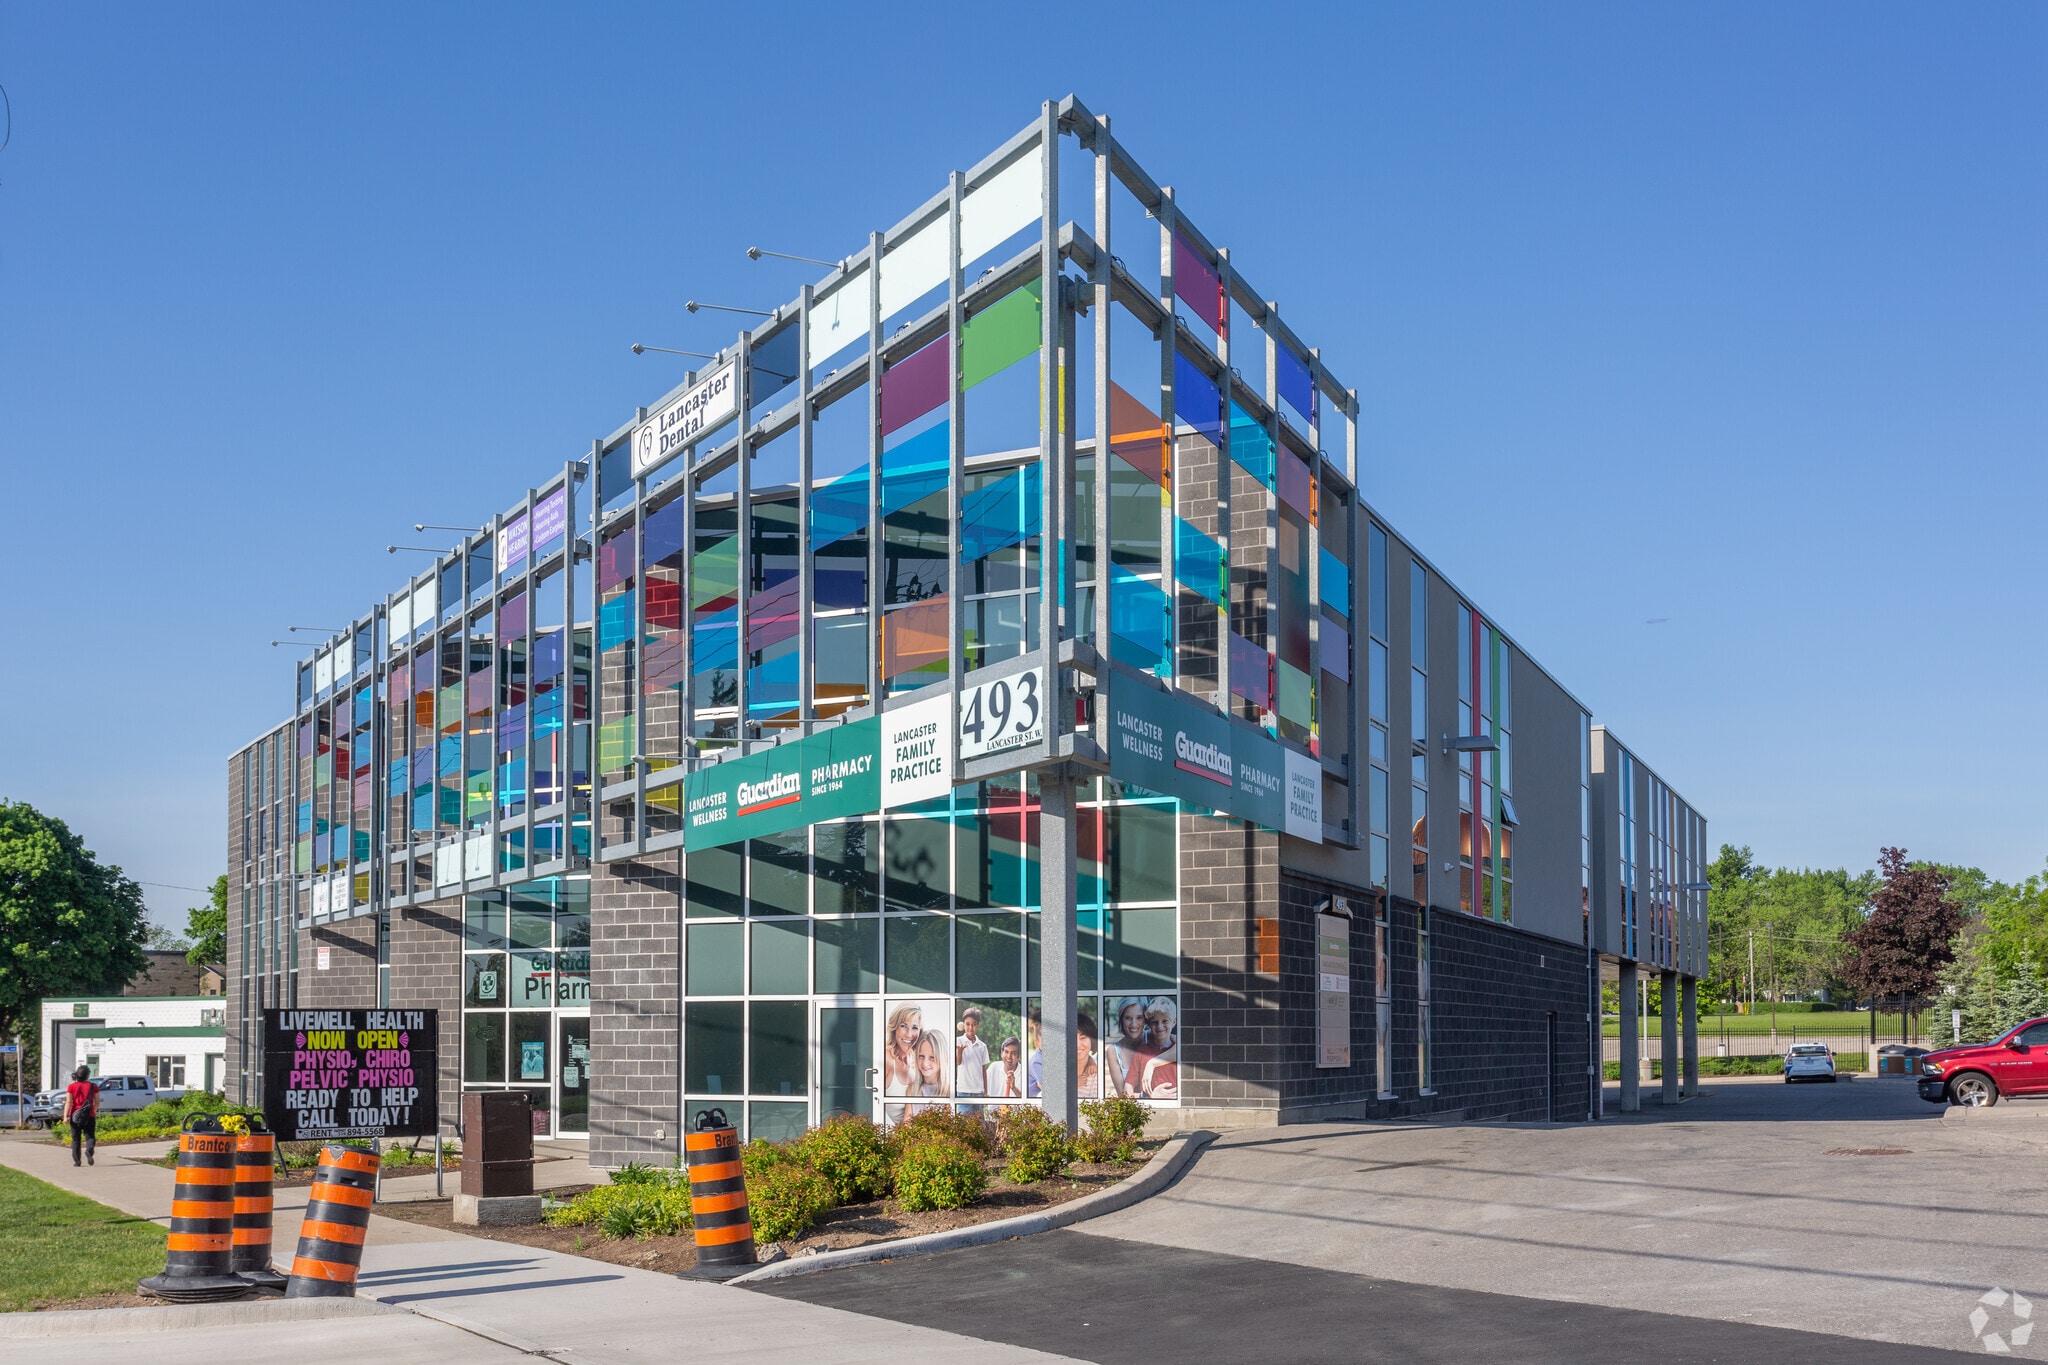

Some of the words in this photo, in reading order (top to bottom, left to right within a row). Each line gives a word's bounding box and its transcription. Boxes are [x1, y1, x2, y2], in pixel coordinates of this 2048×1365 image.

[659, 373, 729, 434] Lancaster
[659, 407, 705, 455] Dental
[508, 519, 527, 540] WATSON
[962, 671, 1039, 744] 493
[893, 722, 937, 744] LANCASTER
[1117, 711, 1163, 743] LANCASTER
[896, 738, 936, 763] FAMILY
[986, 734, 1024, 751] LANCASTER
[1025, 731, 1035, 743] ST.
[1035, 728, 1043, 739] W.
[1122, 733, 1163, 762] WELLNESS
[1174, 730, 1233, 776] Guardian
[811, 754, 872, 785] PHARMACY
[890, 757, 942, 784] PRACTICE
[1240, 763, 1281, 793] PHARMACY
[1291, 771, 1315, 789] LANCASTER
[737, 772, 800, 807] Guardian
[811, 785, 827, 796] SINCE
[828, 780, 843, 792] 1964
[1240, 782, 1253, 795] SINCE
[1254, 785, 1264, 797] 1964
[1293, 787, 1315, 806] FAMILY
[689, 791, 727, 813] LANCASTER
[1290, 803, 1318, 823] PRACTICE
[692, 807, 727, 827] WELLNESS
[279, 1011, 355, 1030] LIVEWELL
[366, 1011, 424, 1030] HEALTH
[307, 1031, 346, 1050] NOW
[357, 1030, 398, 1049] OPEN
[294, 1050, 358, 1069] PHYSIO,
[365, 1050, 411, 1068] CHIRO
[289, 1070, 349, 1089] PELVIC
[358, 1068, 414, 1088] PHYSIO
[285, 1088, 339, 1109] READY
[350, 1088, 371, 1107] TO
[381, 1087, 419, 1106] HELP
[297, 1108, 339, 1129] CALL
[310, 1129, 333, 1138] RENT
[347, 1127, 384, 1136] 894-5568
[187, 1135, 231, 1153] Brantco
